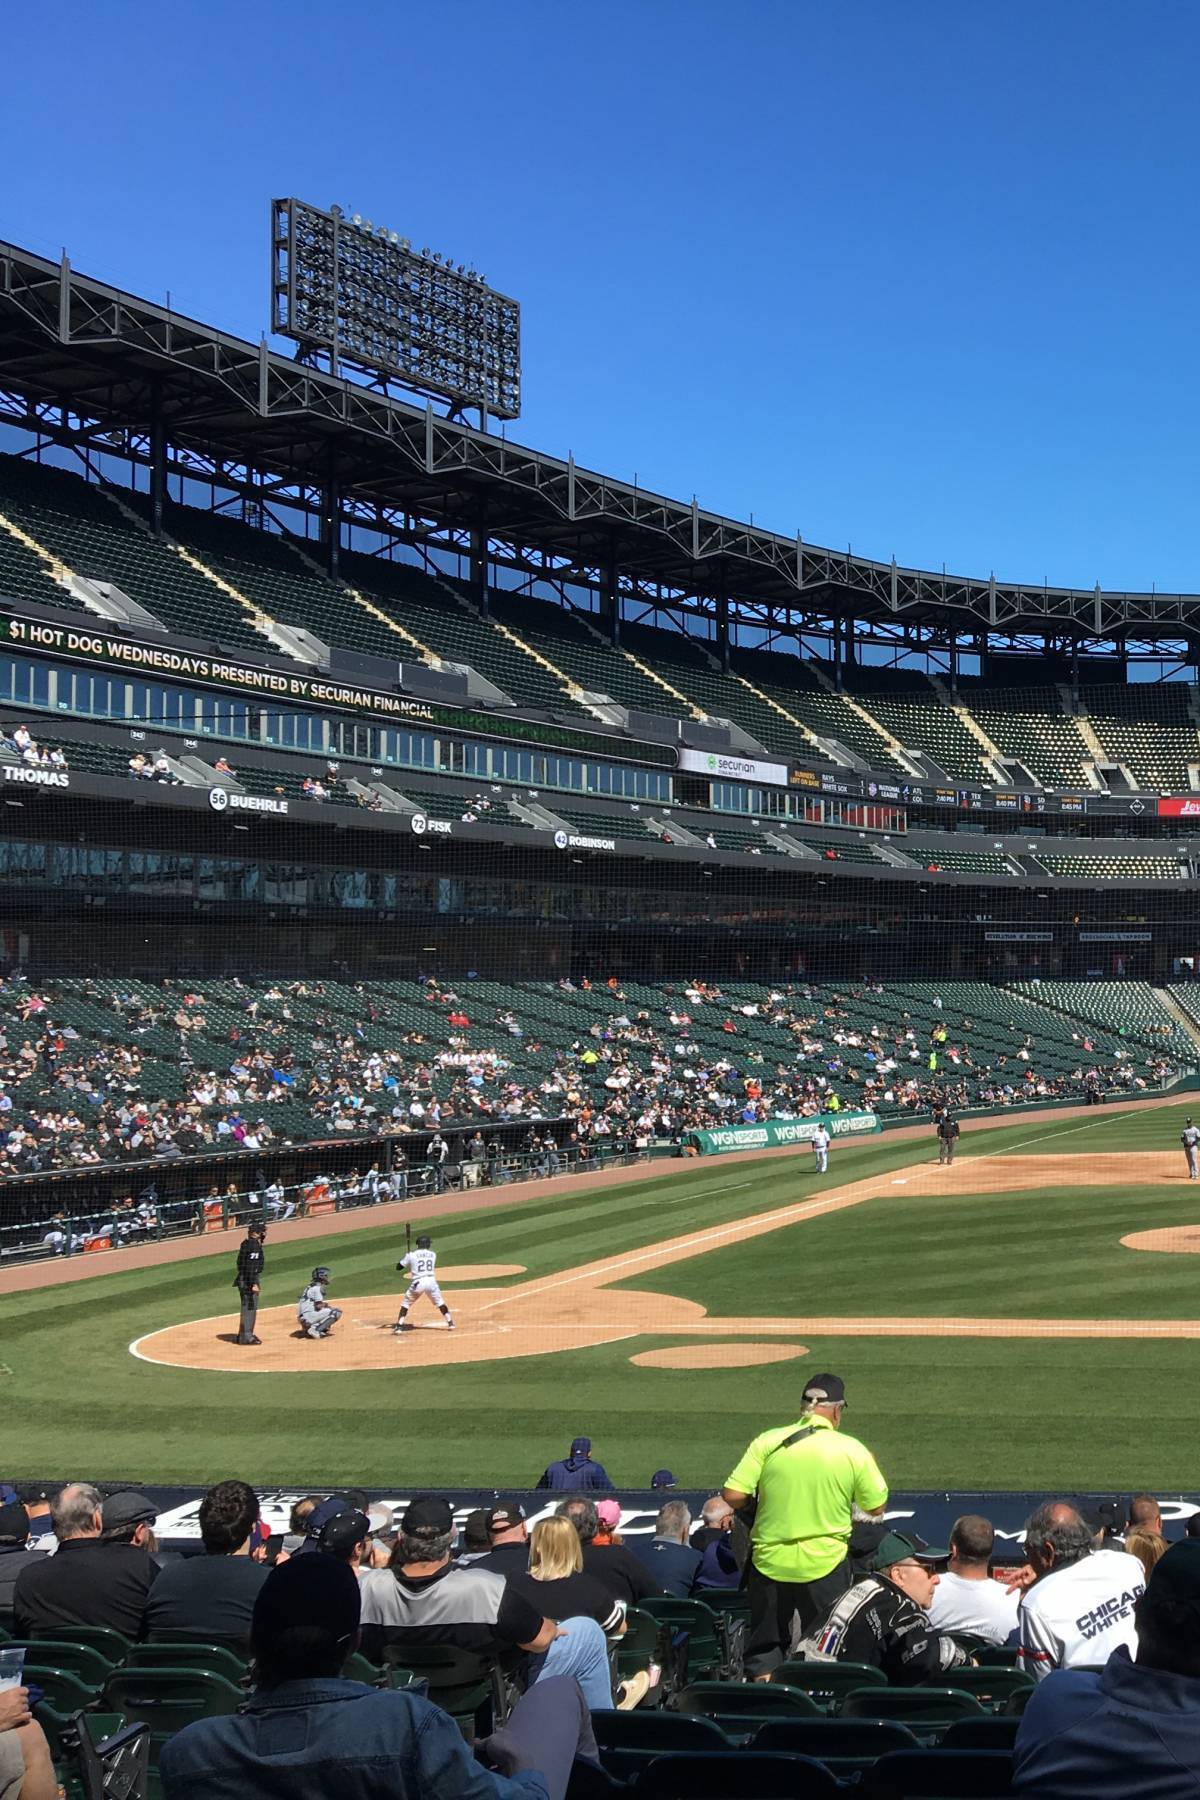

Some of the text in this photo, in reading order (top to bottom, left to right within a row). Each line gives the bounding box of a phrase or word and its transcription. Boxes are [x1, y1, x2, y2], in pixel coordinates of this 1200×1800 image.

[9, 621, 434, 719] $1 HOT DOG WEDNESDAYS PRESENTED BY SECURIAN FINANCIAL
[718, 758, 755, 773] securian
[2, 765, 70, 787] THOMAS
[822, 783, 837, 791] WHITE
[212, 793, 288, 814] 56 BUEHRLE
[413, 819, 452, 833] 72 FISK
[556, 834, 615, 850] 42 ROBINSON
[709, 1131, 738, 1146] WGN
[774, 1126, 800, 1140] WGN
[418, 1260, 432, 1272] 28
[1076, 1584, 1144, 1631] CHICAG
[1081, 1607, 1131, 1640] WHITE
